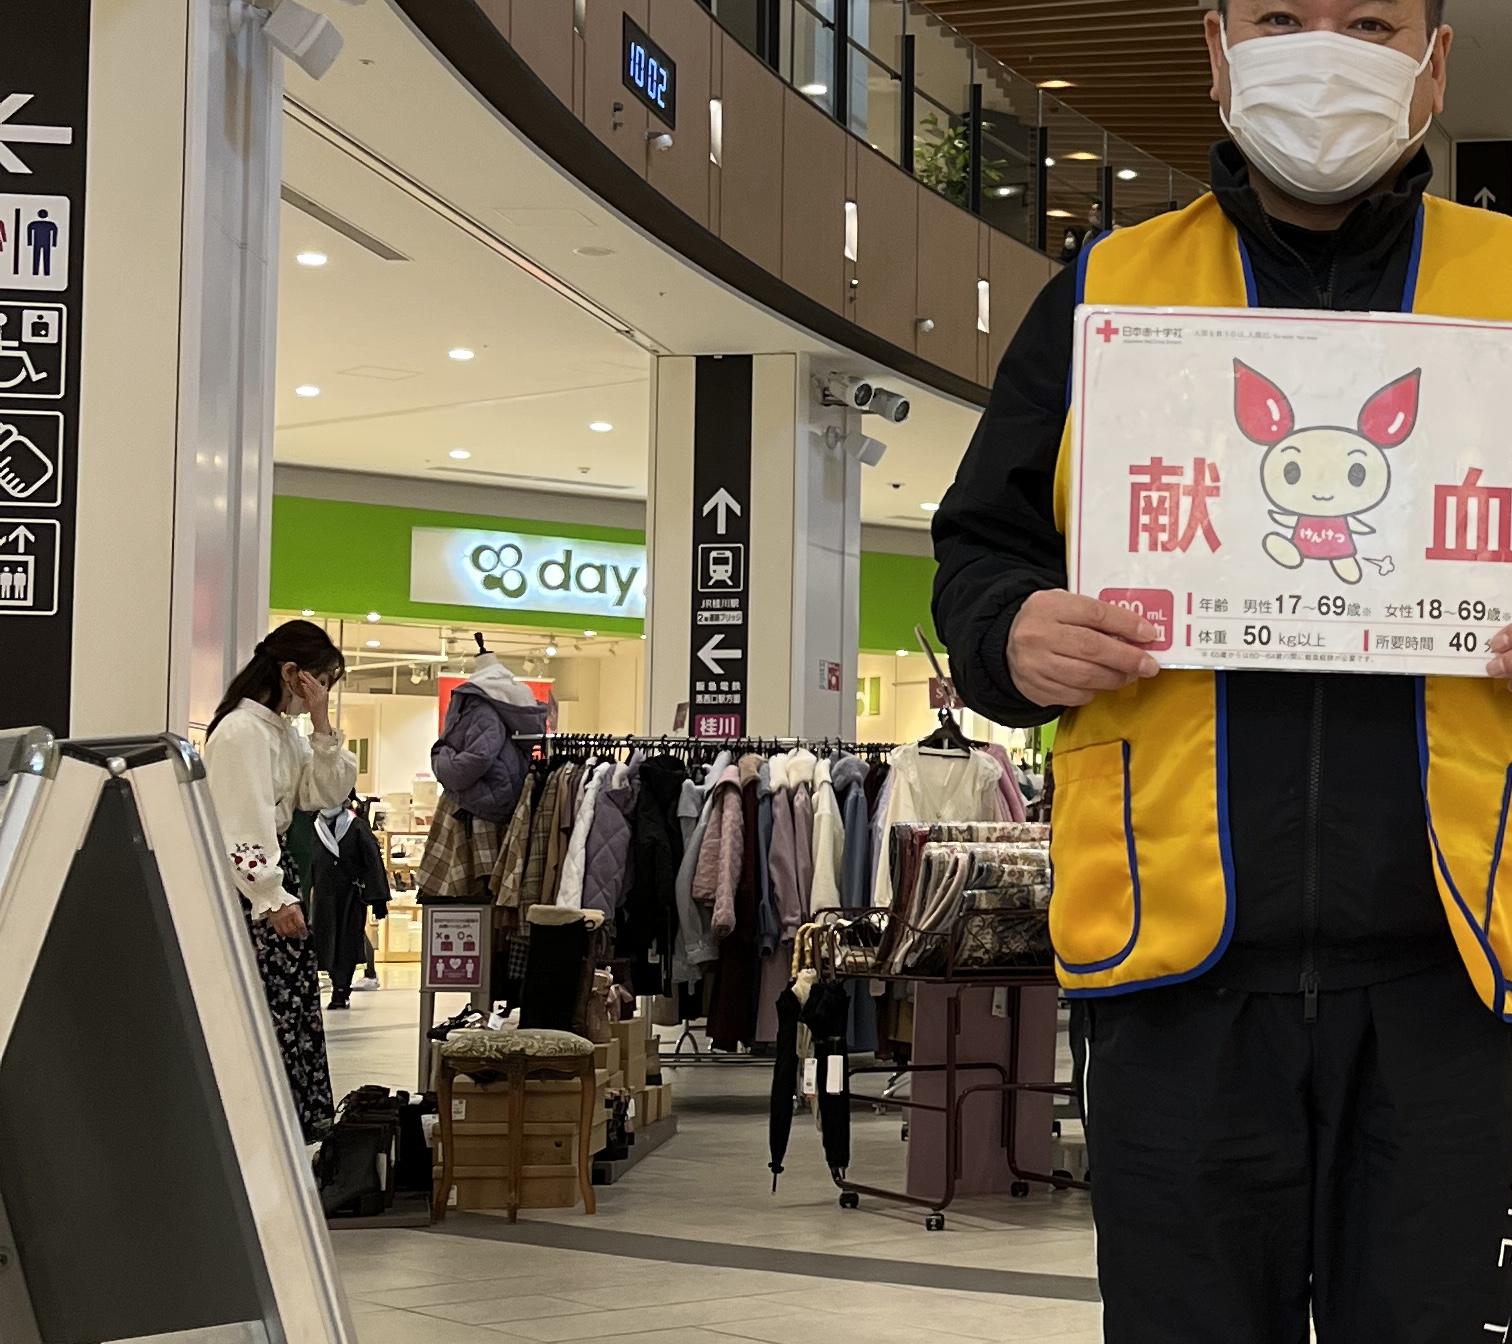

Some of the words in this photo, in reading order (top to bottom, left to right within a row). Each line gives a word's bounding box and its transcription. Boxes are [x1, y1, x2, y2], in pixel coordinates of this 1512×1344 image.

[1128, 456, 1222, 554] 献
[1300, 528, 1345, 543] けんけつ
[1199, 598, 1228, 612] 年齢
[1199, 629, 1227, 645] 体重
[1243, 625, 1271, 646] 50
[1376, 635, 1434, 651] 所要時間
[700, 717, 735, 736] 桂川
